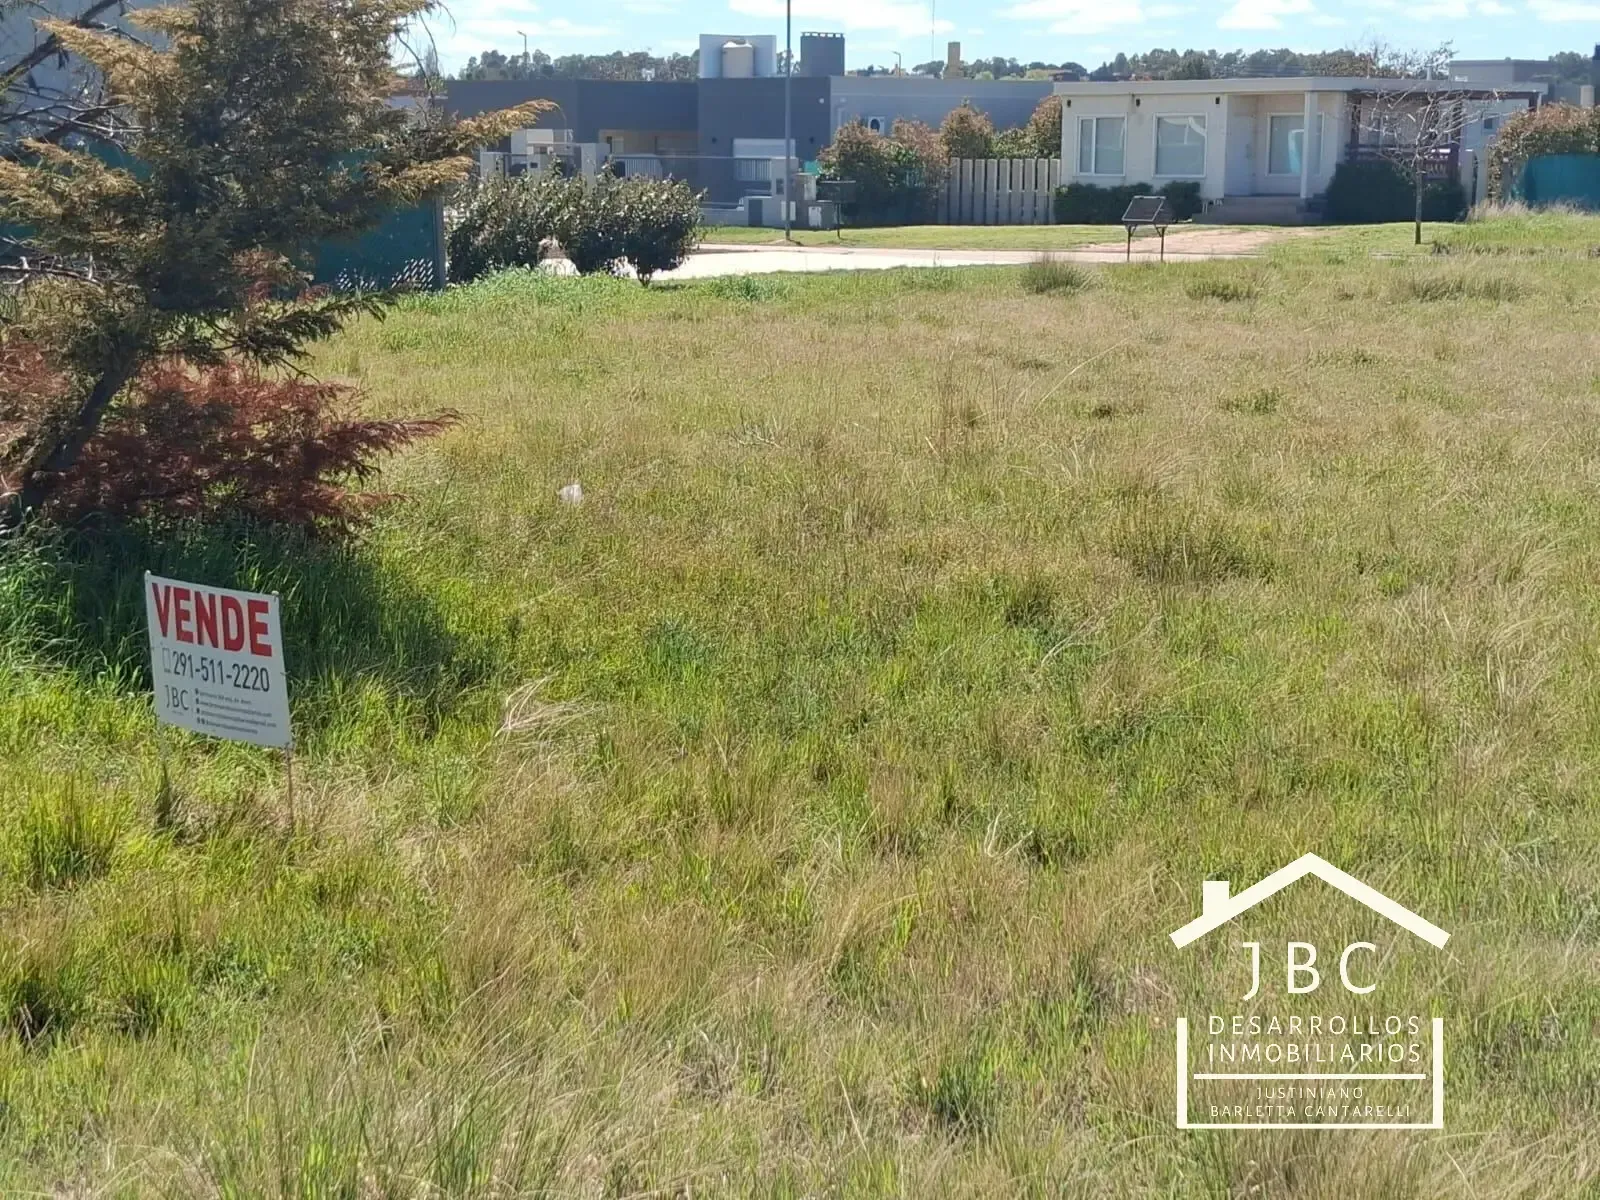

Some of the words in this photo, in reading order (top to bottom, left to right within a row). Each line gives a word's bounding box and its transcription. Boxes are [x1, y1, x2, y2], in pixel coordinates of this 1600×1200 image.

[152, 582, 272, 657] VENDE
[172, 650, 270, 693] 291-511-2220
[165, 684, 190, 711] JBC
